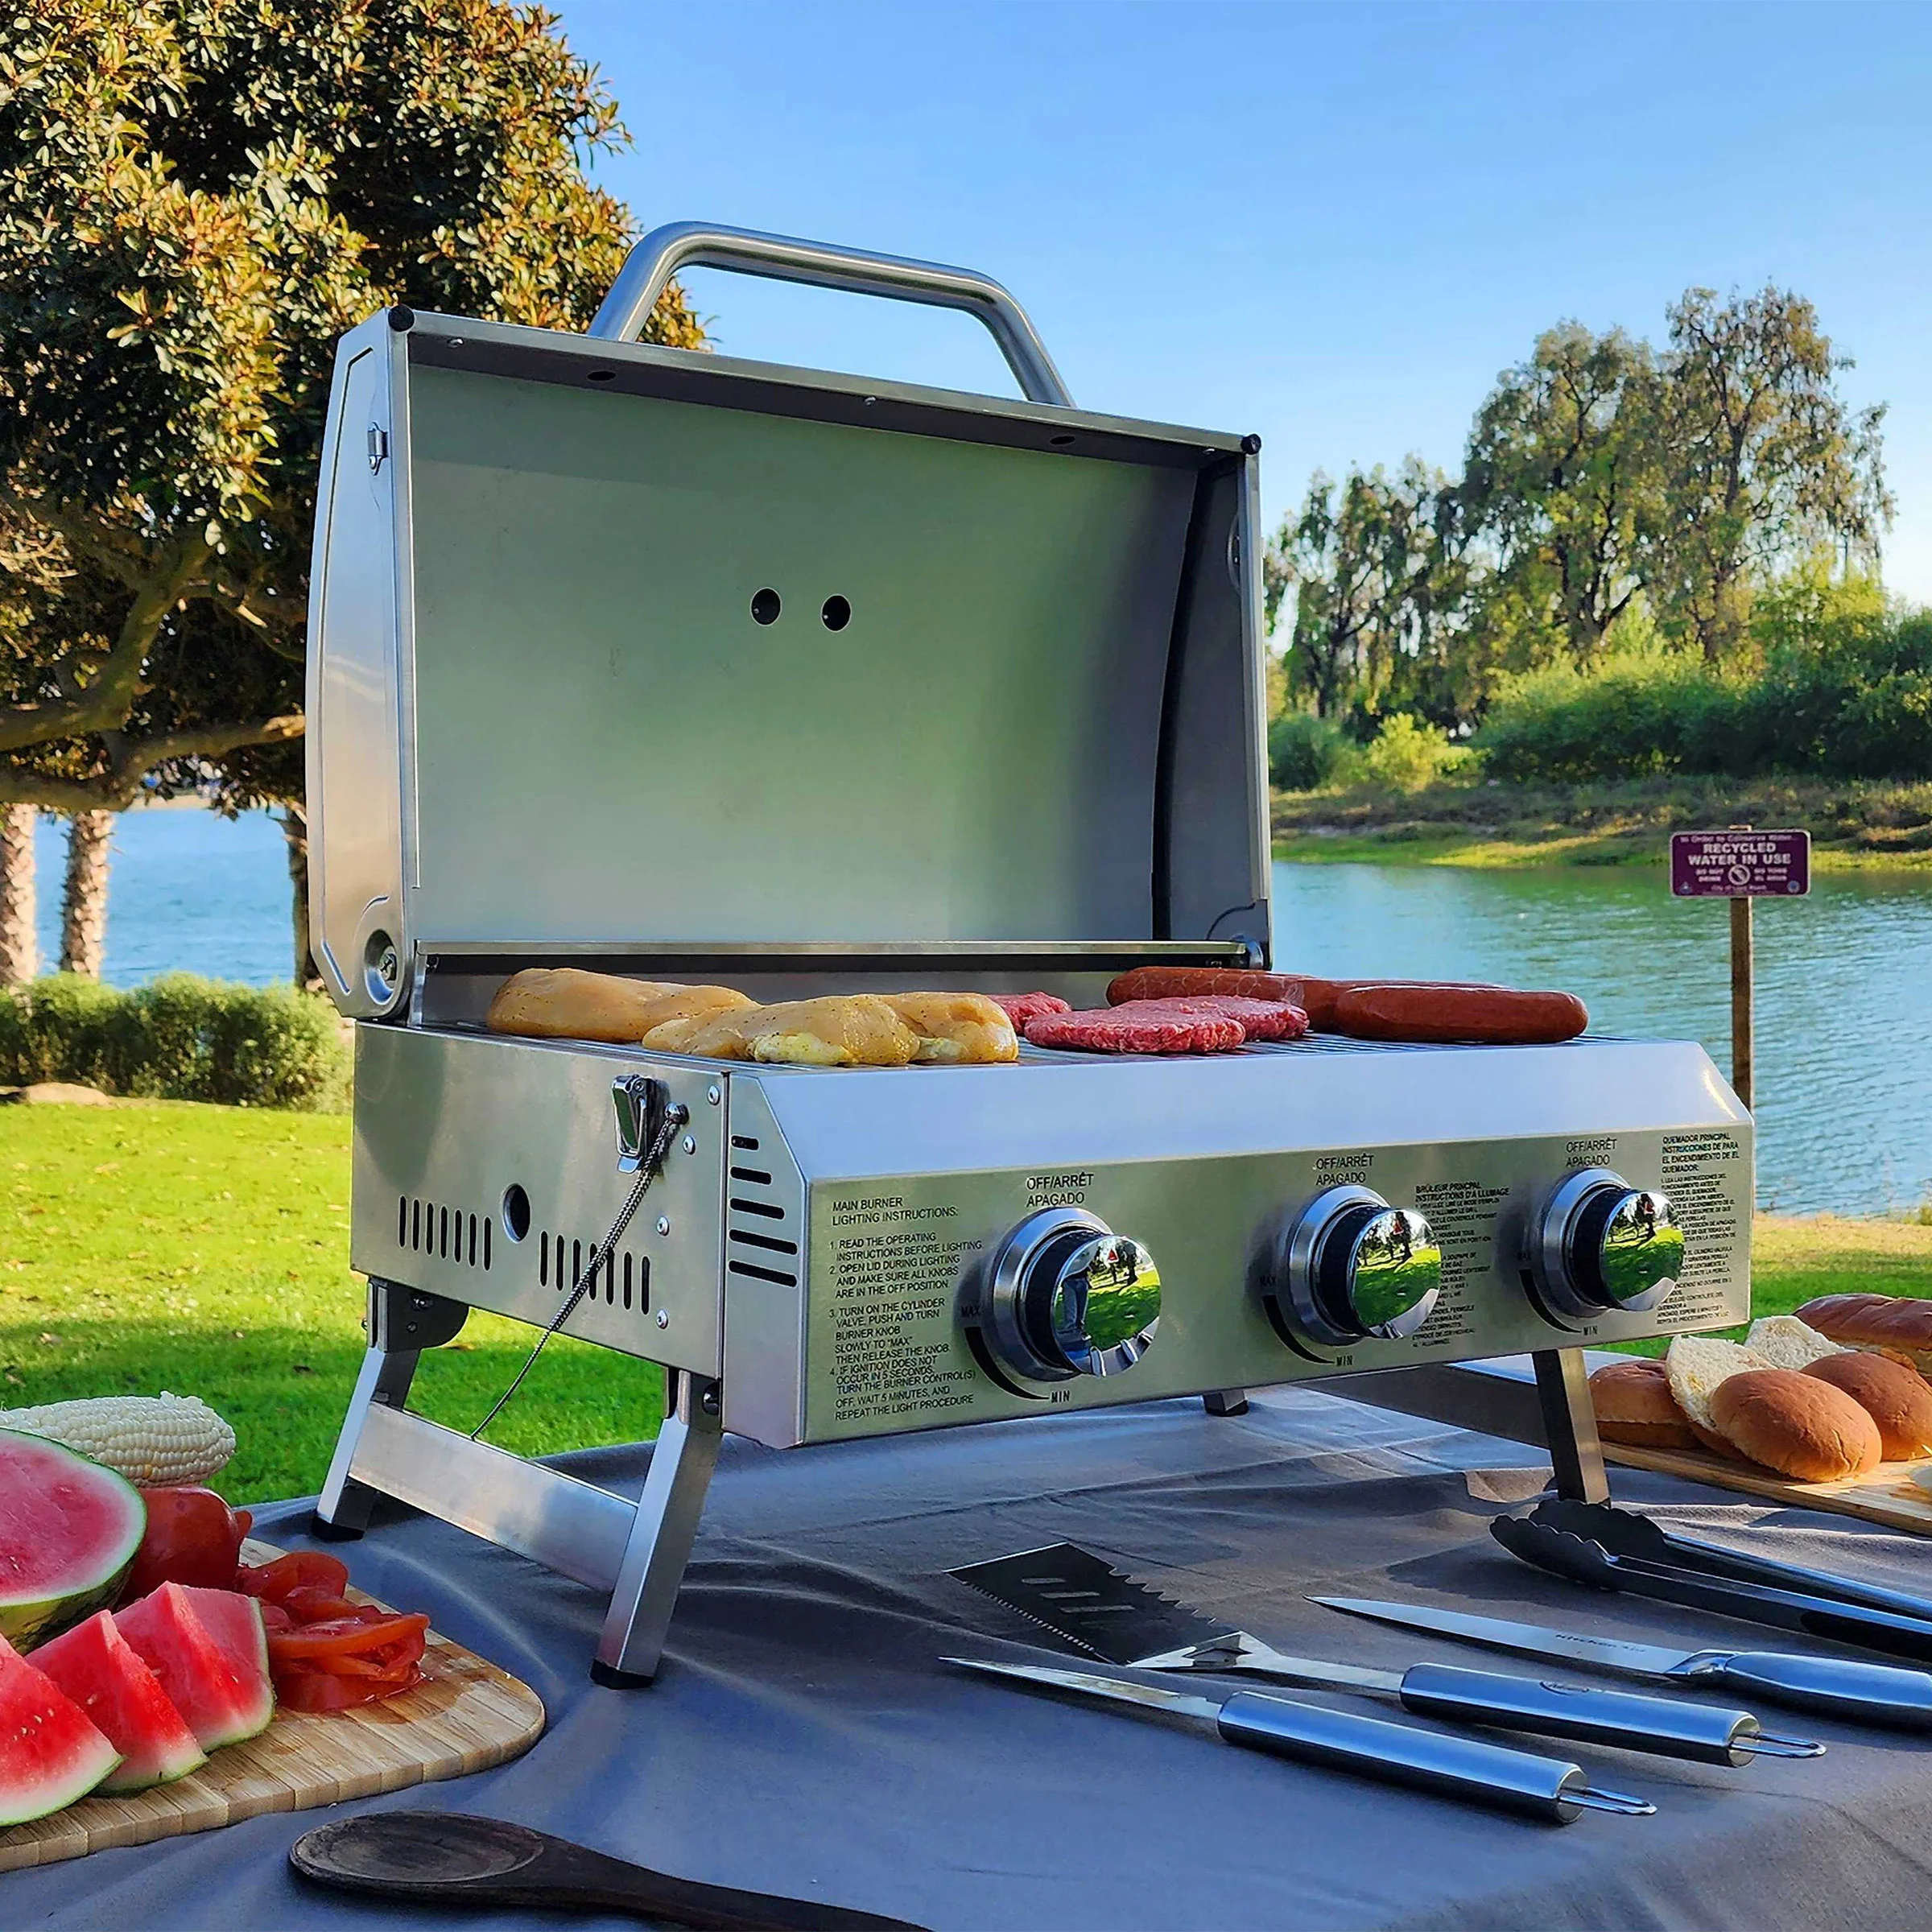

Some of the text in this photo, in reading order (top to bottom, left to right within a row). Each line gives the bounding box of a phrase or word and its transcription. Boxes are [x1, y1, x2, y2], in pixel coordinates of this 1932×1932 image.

[1703, 843, 1776, 853] RECYCLED
[1688, 853, 1791, 865] WATER IN USE
[1567, 1137, 1617, 1153] OFF/ARRÊT
[1315, 1153, 1374, 1170] OFF/ARRÊT
[1567, 1154, 1610, 1167] APAGADO
[1026, 1172, 1094, 1190] OFF/ARRÊT
[1315, 1171, 1366, 1186] APAGADO
[833, 1198, 902, 1212] MAIN BURNER
[1026, 1192, 1084, 1208] APAGADO
[833, 1207, 958, 1225] LIGHTING INSTRUCTIONS:
[839, 1239, 864, 1249] READ
[866, 1237, 883, 1246] THE
[886, 1232, 935, 1245] OPERATING
[836, 1248, 902, 1261] INSTRUCTIONS
[905, 1244, 940, 1255] BEFORE
[839, 1264, 865, 1274] OPEN
[867, 1262, 881, 1271] LID
[883, 1259, 917, 1269] DURING
[919, 1254, 960, 1265] LIGHTING
[836, 1266, 959, 1286] AND MAKE SURE ALL KNOBS
[836, 1289, 853, 1298] ARE
[857, 1287, 865, 1296] IN
[868, 1286, 885, 1295] THE
[887, 1283, 905, 1294] OFF
[839, 1307, 863, 1317] TURN
[866, 1306, 879, 1314] ON
[881, 1302, 899, 1312] THE
[901, 1298, 945, 1311] CYLINDER
[869, 1314, 893, 1324] PUSH
[895, 1312, 913, 1322] AND
[916, 1310, 939, 1319] TURN
[836, 1326, 900, 1340] BURNER KNOB
[1583, 1326, 1598, 1335] MIN
[835, 1342, 871, 1353] SLOWLY
[873, 1340, 885, 1348] TO
[836, 1355, 860, 1364] THEN
[862, 1348, 902, 1361] RELEASE
[905, 1346, 923, 1356] THE
[1336, 1356, 1353, 1366] MIN
[839, 1366, 848, 1374] IF
[850, 1360, 890, 1373] IGNITION
[892, 1358, 916, 1368] DOES
[919, 1356, 937, 1364] NOT
[836, 1373, 869, 1385] OCCUR
[871, 1372, 881, 1381] IN
[882, 1370, 888, 1379] 5
[837, 1369, 976, 1394] TURN THE BURNER CONTROL(S)
[857, 1394, 879, 1405] WAIT
[881, 1393, 886, 1402] 5
[932, 1385, 950, 1395] AND
[1051, 1390, 1070, 1403] MIN
[835, 1394, 973, 1421] REPEAT THE LIGHT PROCEDURE
